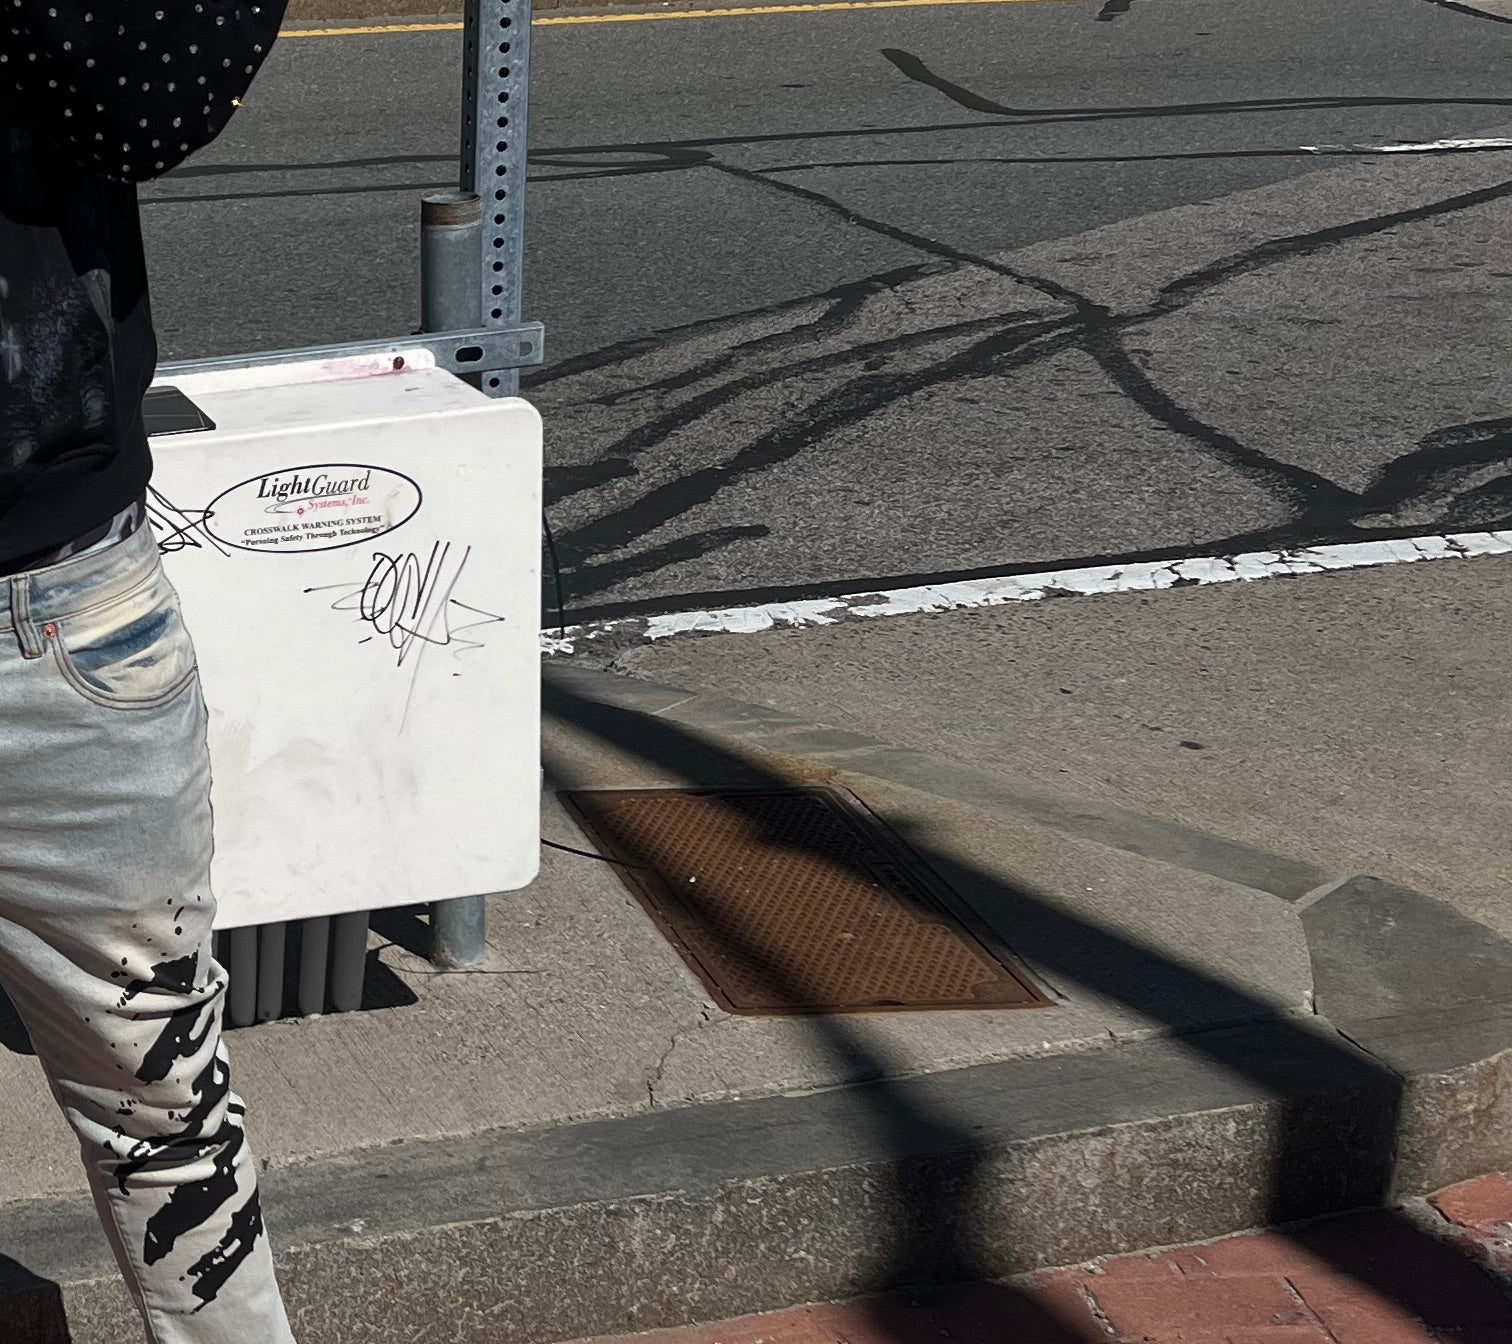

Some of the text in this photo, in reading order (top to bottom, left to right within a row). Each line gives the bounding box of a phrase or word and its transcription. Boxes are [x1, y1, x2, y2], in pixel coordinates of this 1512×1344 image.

[256, 470, 371, 502] LightGuard
[244, 516, 381, 536] CROSSWALK WARNING SYSTEM
[280, 533, 303, 542] Safety
[305, 530, 337, 540] Through
